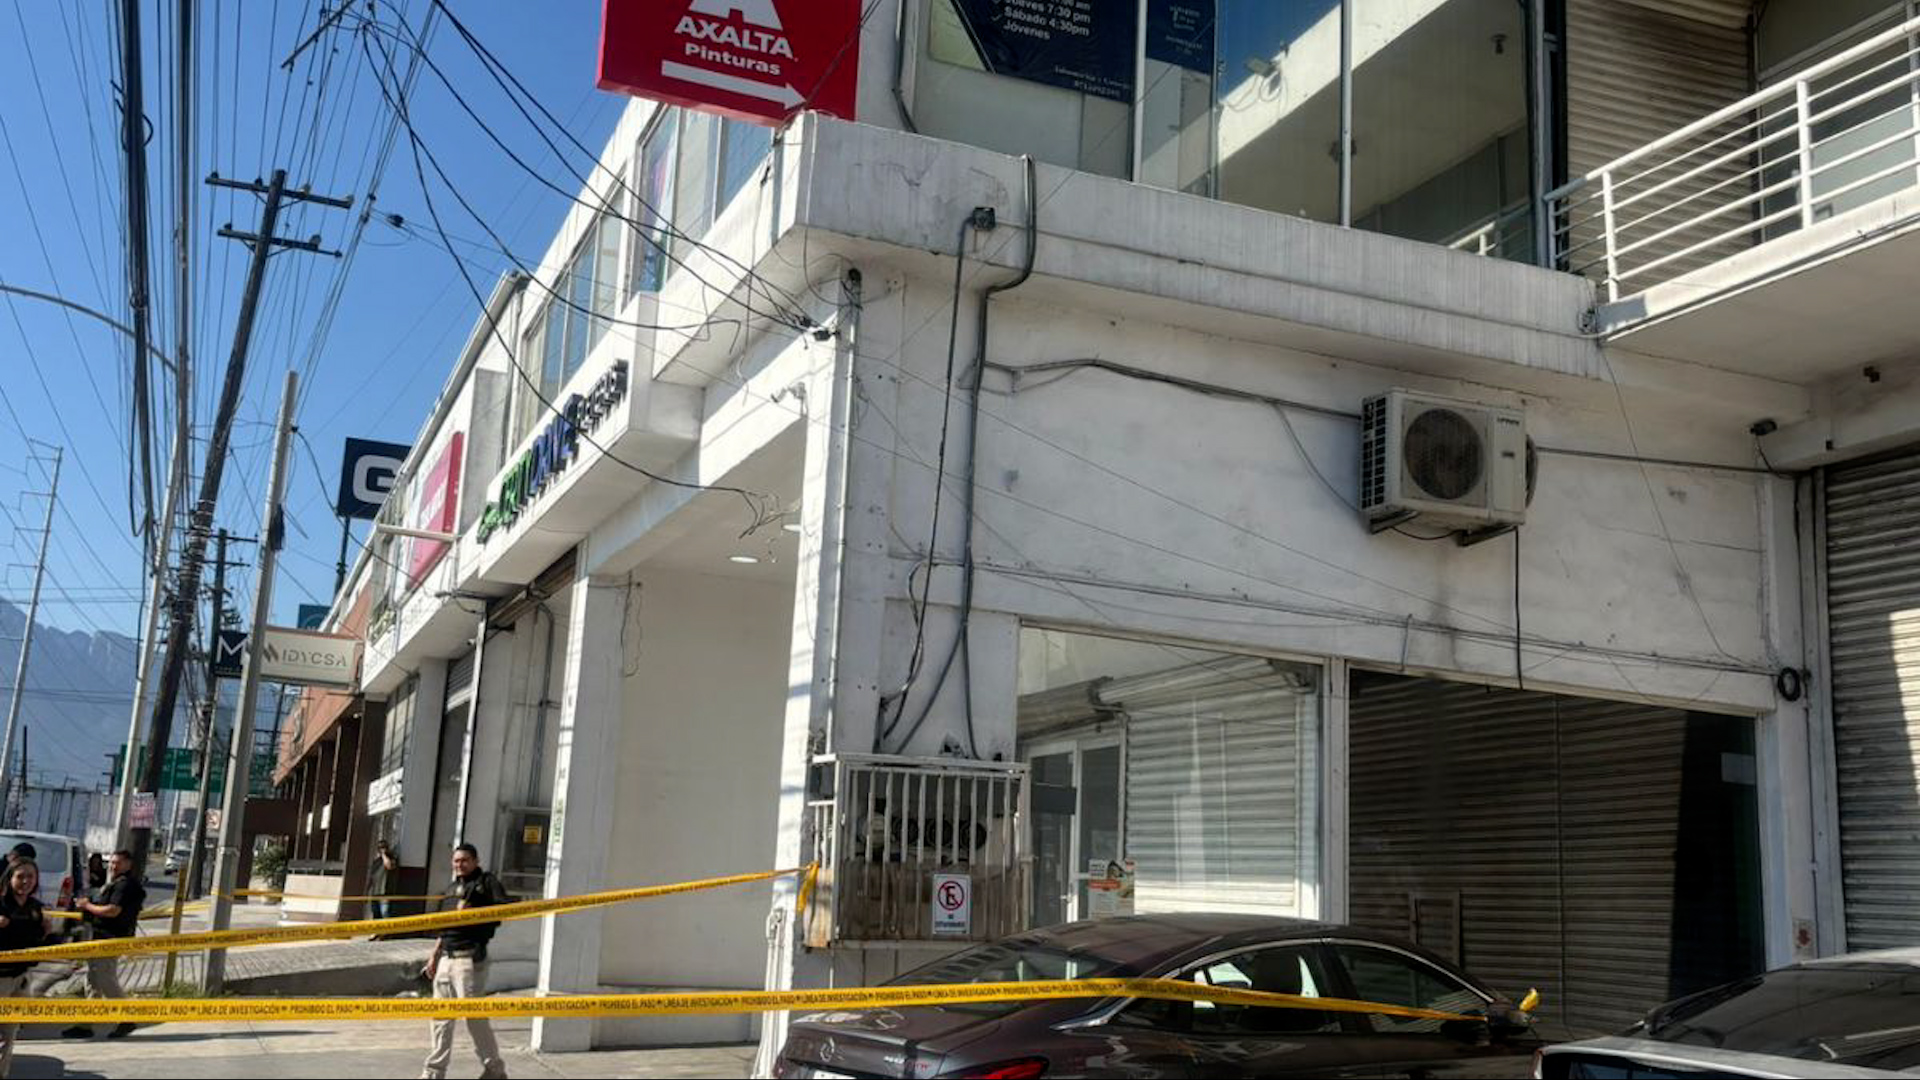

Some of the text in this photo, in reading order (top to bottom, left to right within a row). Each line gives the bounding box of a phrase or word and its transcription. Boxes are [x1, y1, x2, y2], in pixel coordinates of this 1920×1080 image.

[1004, 6, 1047, 26] Sábado
[1073, 13, 1091, 24] pm
[674, 15, 794, 60] AXALTA
[1003, 20, 1050, 40] Jóvenes
[685, 42, 781, 76] Pinturas
